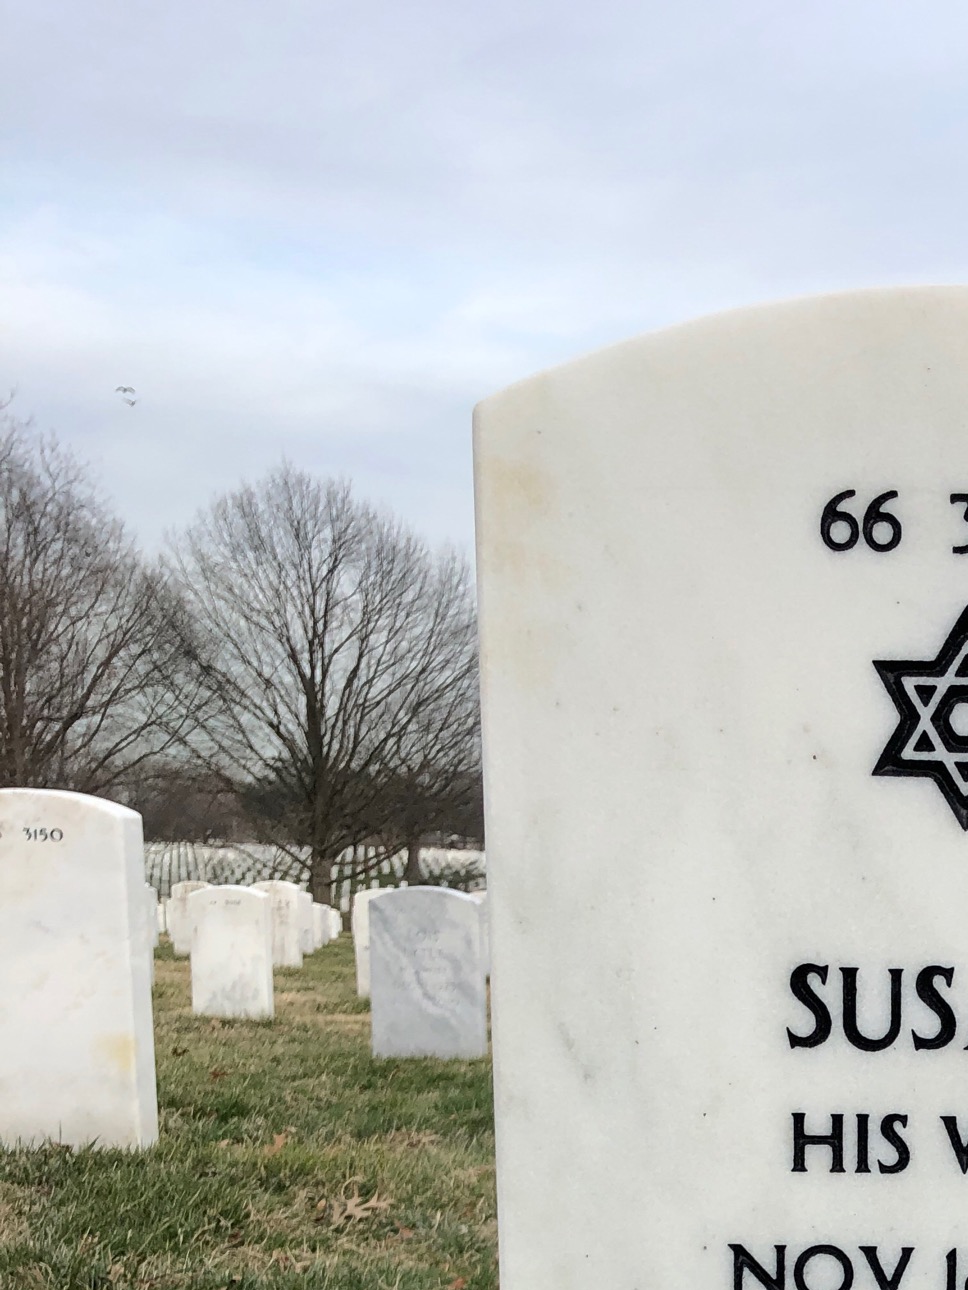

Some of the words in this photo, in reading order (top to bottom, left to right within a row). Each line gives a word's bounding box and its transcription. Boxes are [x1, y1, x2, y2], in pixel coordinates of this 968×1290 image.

[818, 488, 903, 553] 66
[22, 827, 64, 842] 3150
[790, 1112, 911, 1174] HIS
